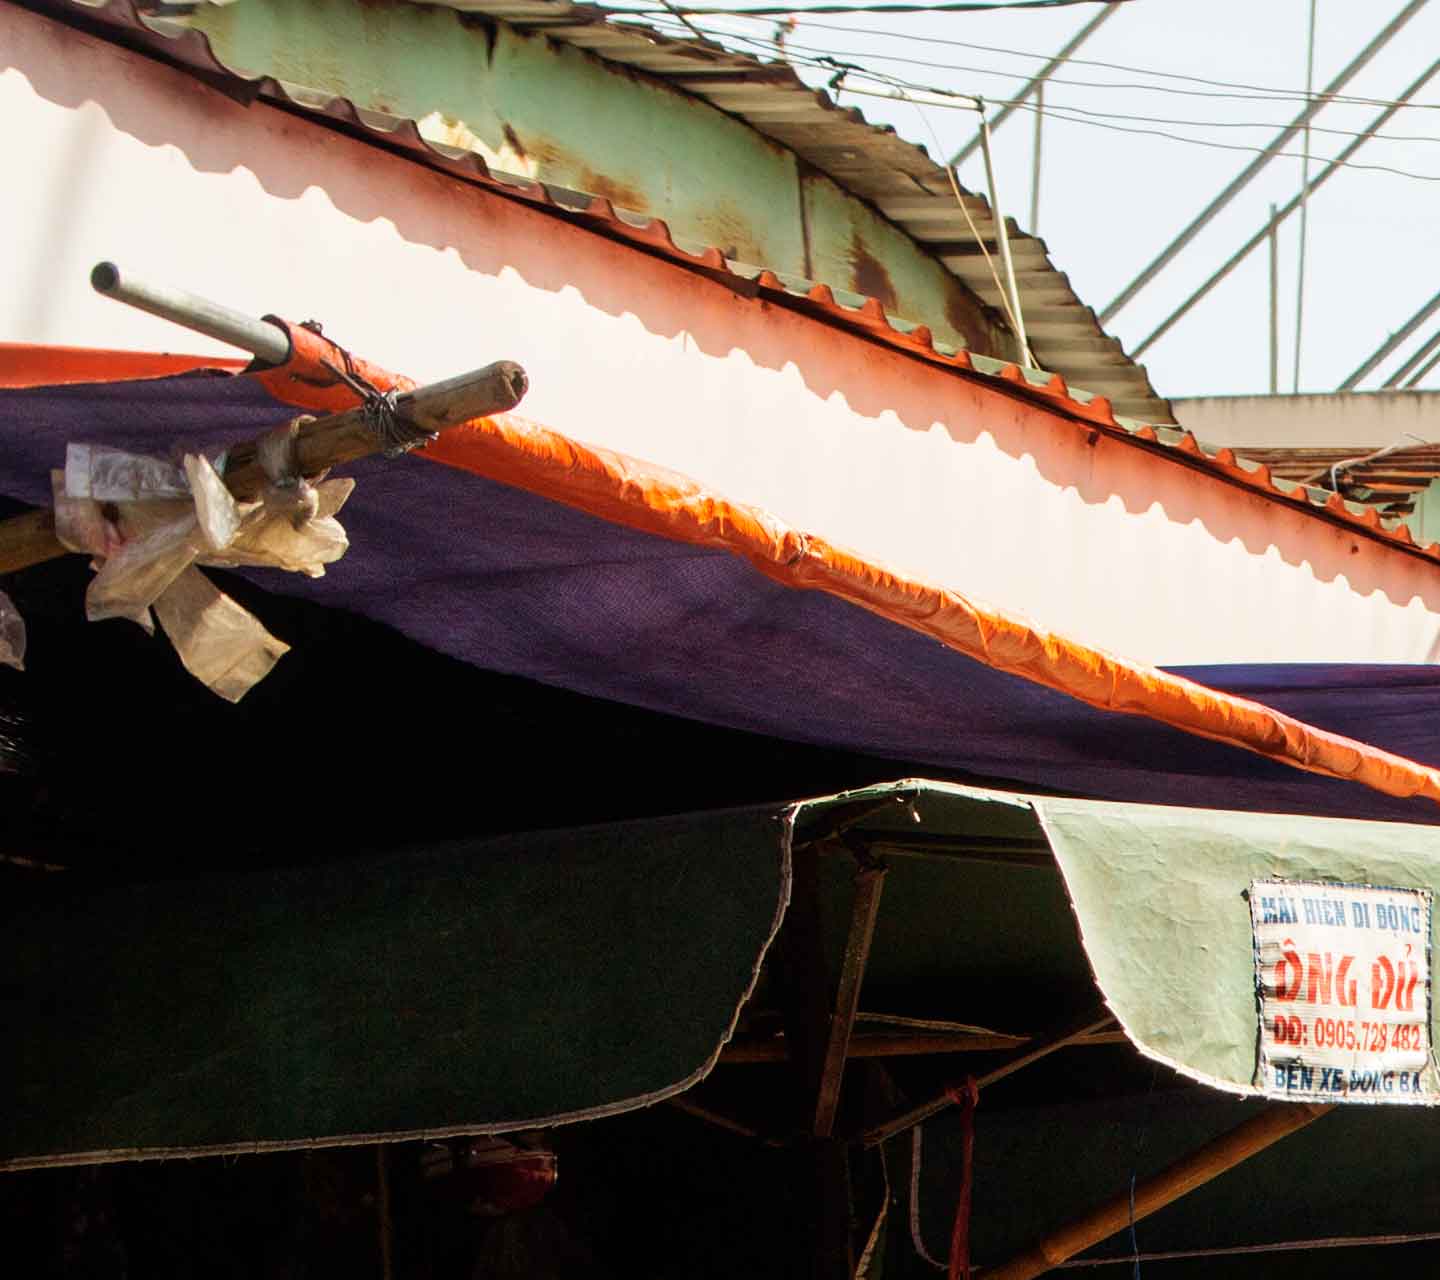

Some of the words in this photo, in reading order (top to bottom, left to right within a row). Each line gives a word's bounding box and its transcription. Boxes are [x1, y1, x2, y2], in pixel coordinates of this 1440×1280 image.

[1351, 901, 1371, 929] DI
[1273, 937, 1358, 1007] ÔNG
[1320, 1066, 1344, 1092] XE
